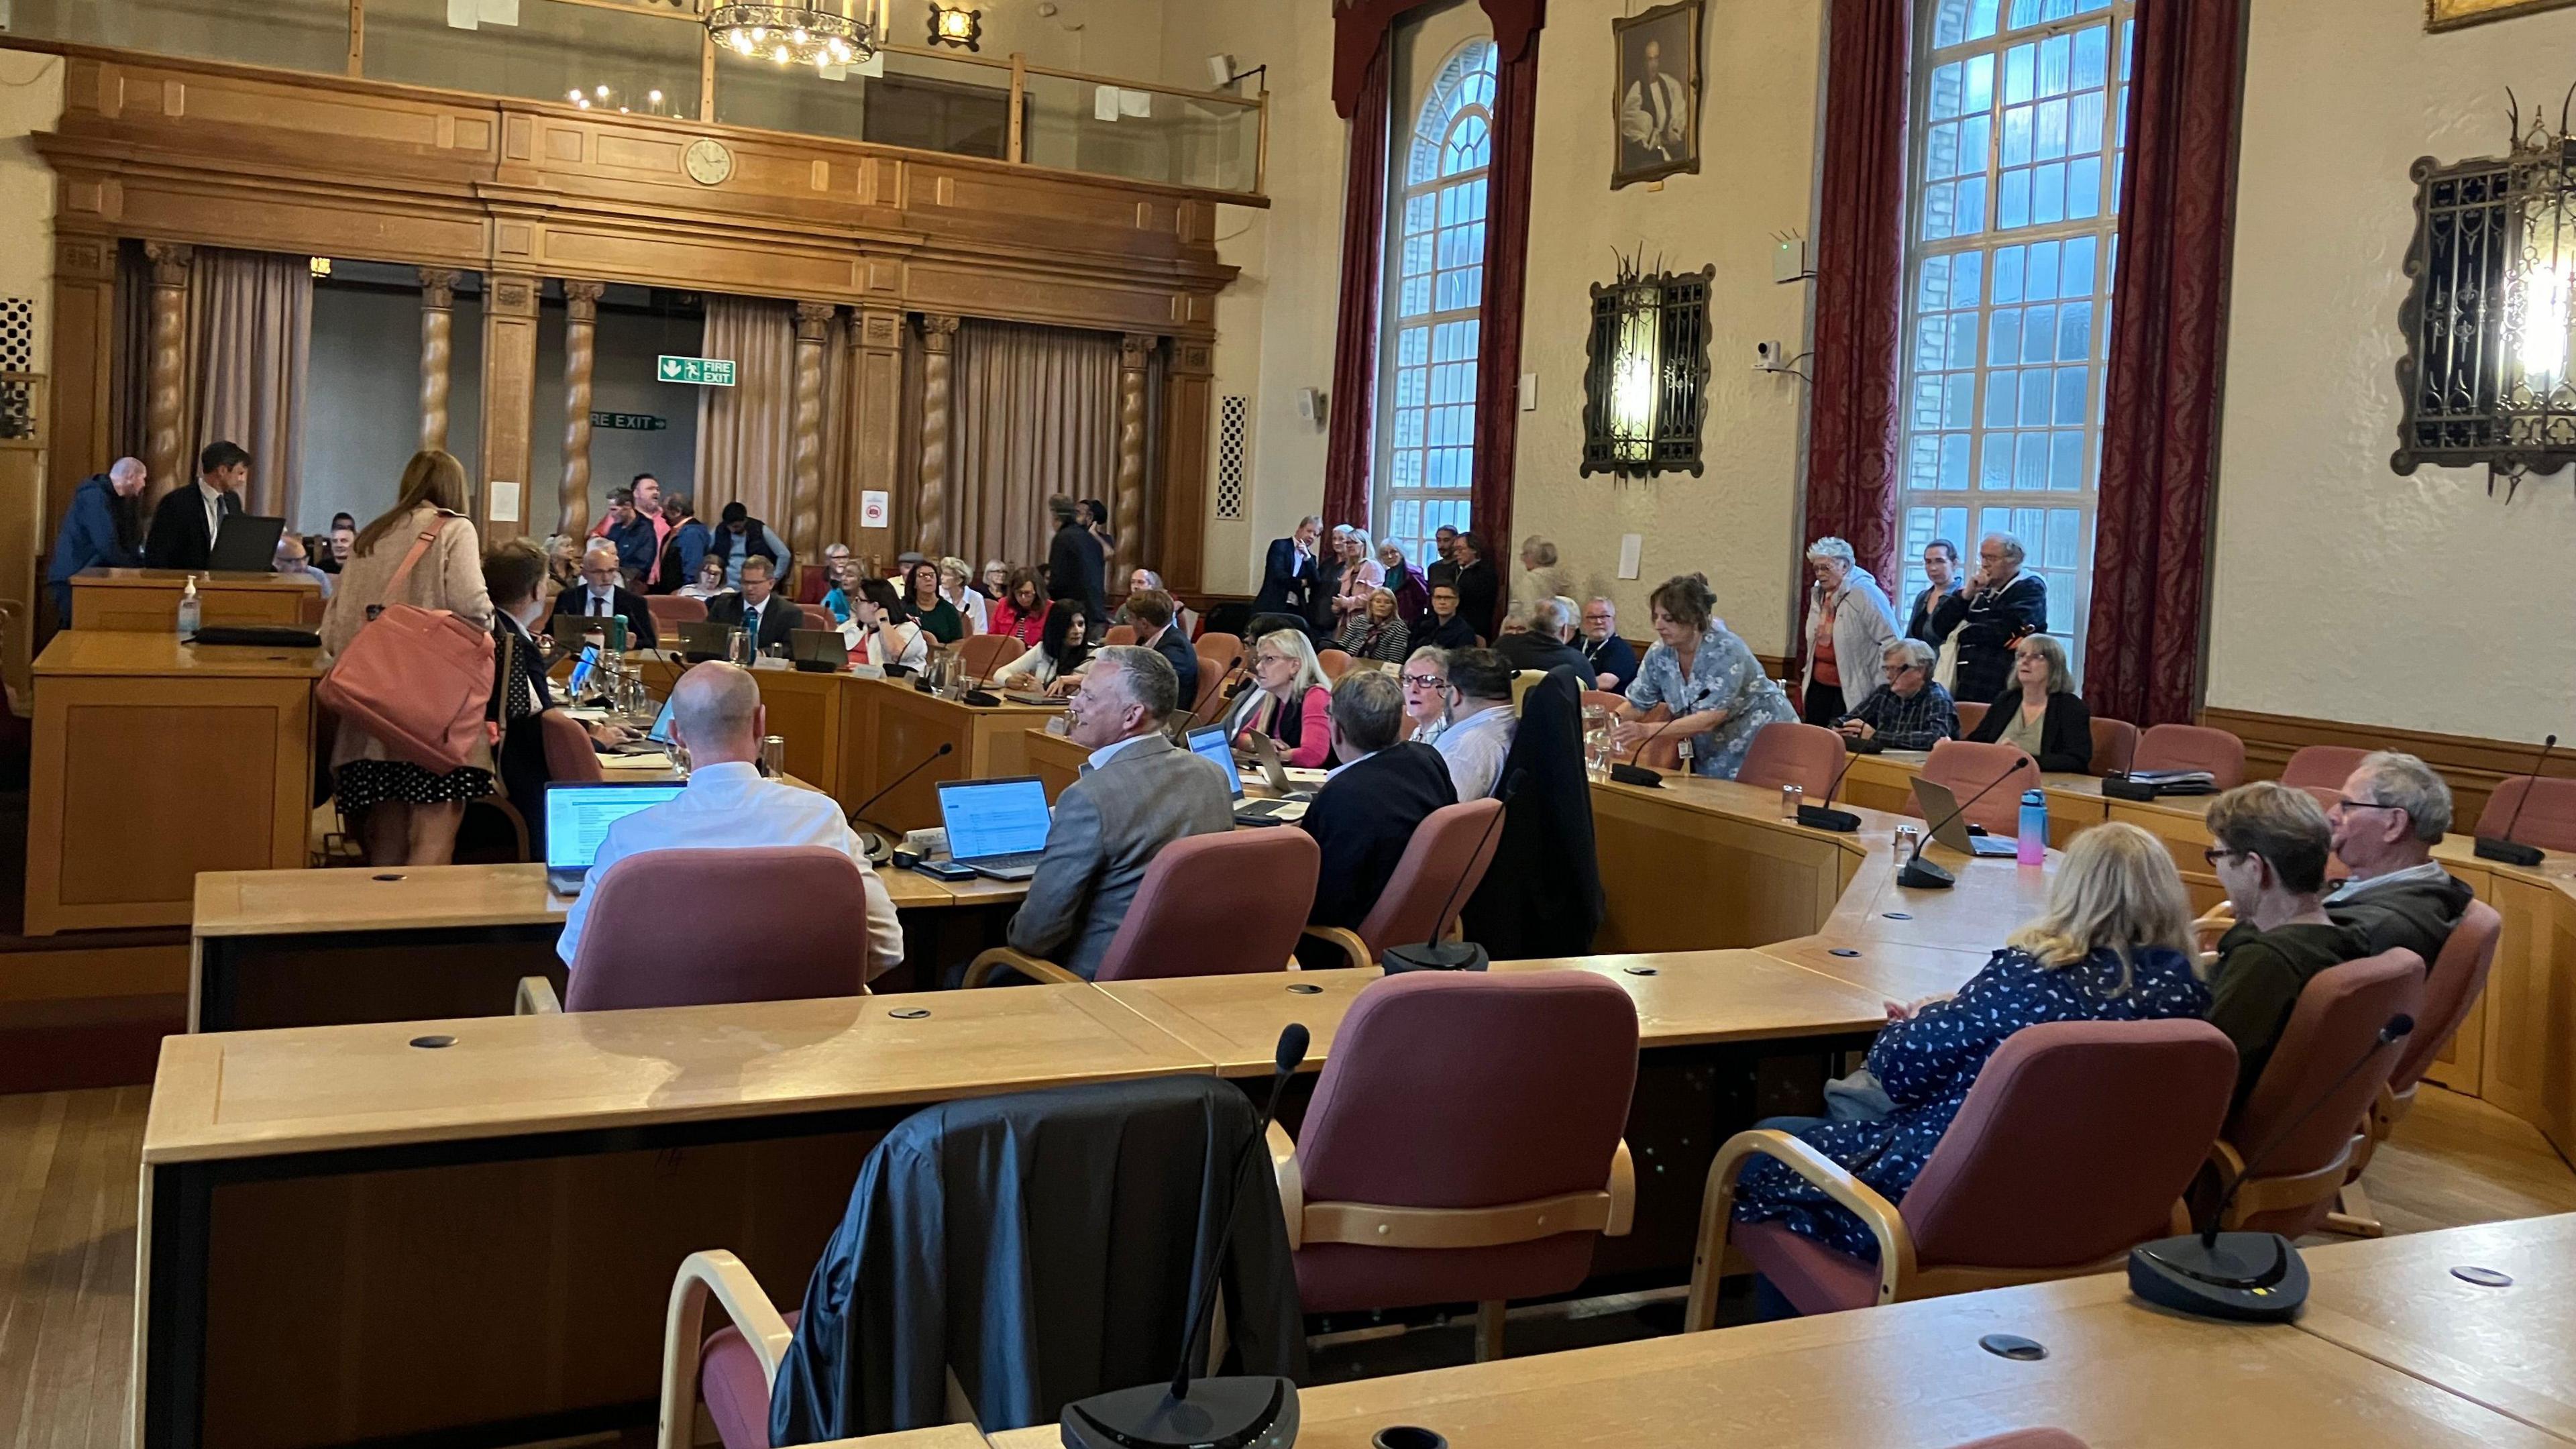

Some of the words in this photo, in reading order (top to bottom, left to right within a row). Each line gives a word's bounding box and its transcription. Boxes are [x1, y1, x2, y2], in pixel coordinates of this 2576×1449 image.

[704, 362, 731, 373] FIRE
[703, 372, 731, 384] EXIT
[590, 413, 609, 426] RE
[615, 415, 652, 429] EXIT
